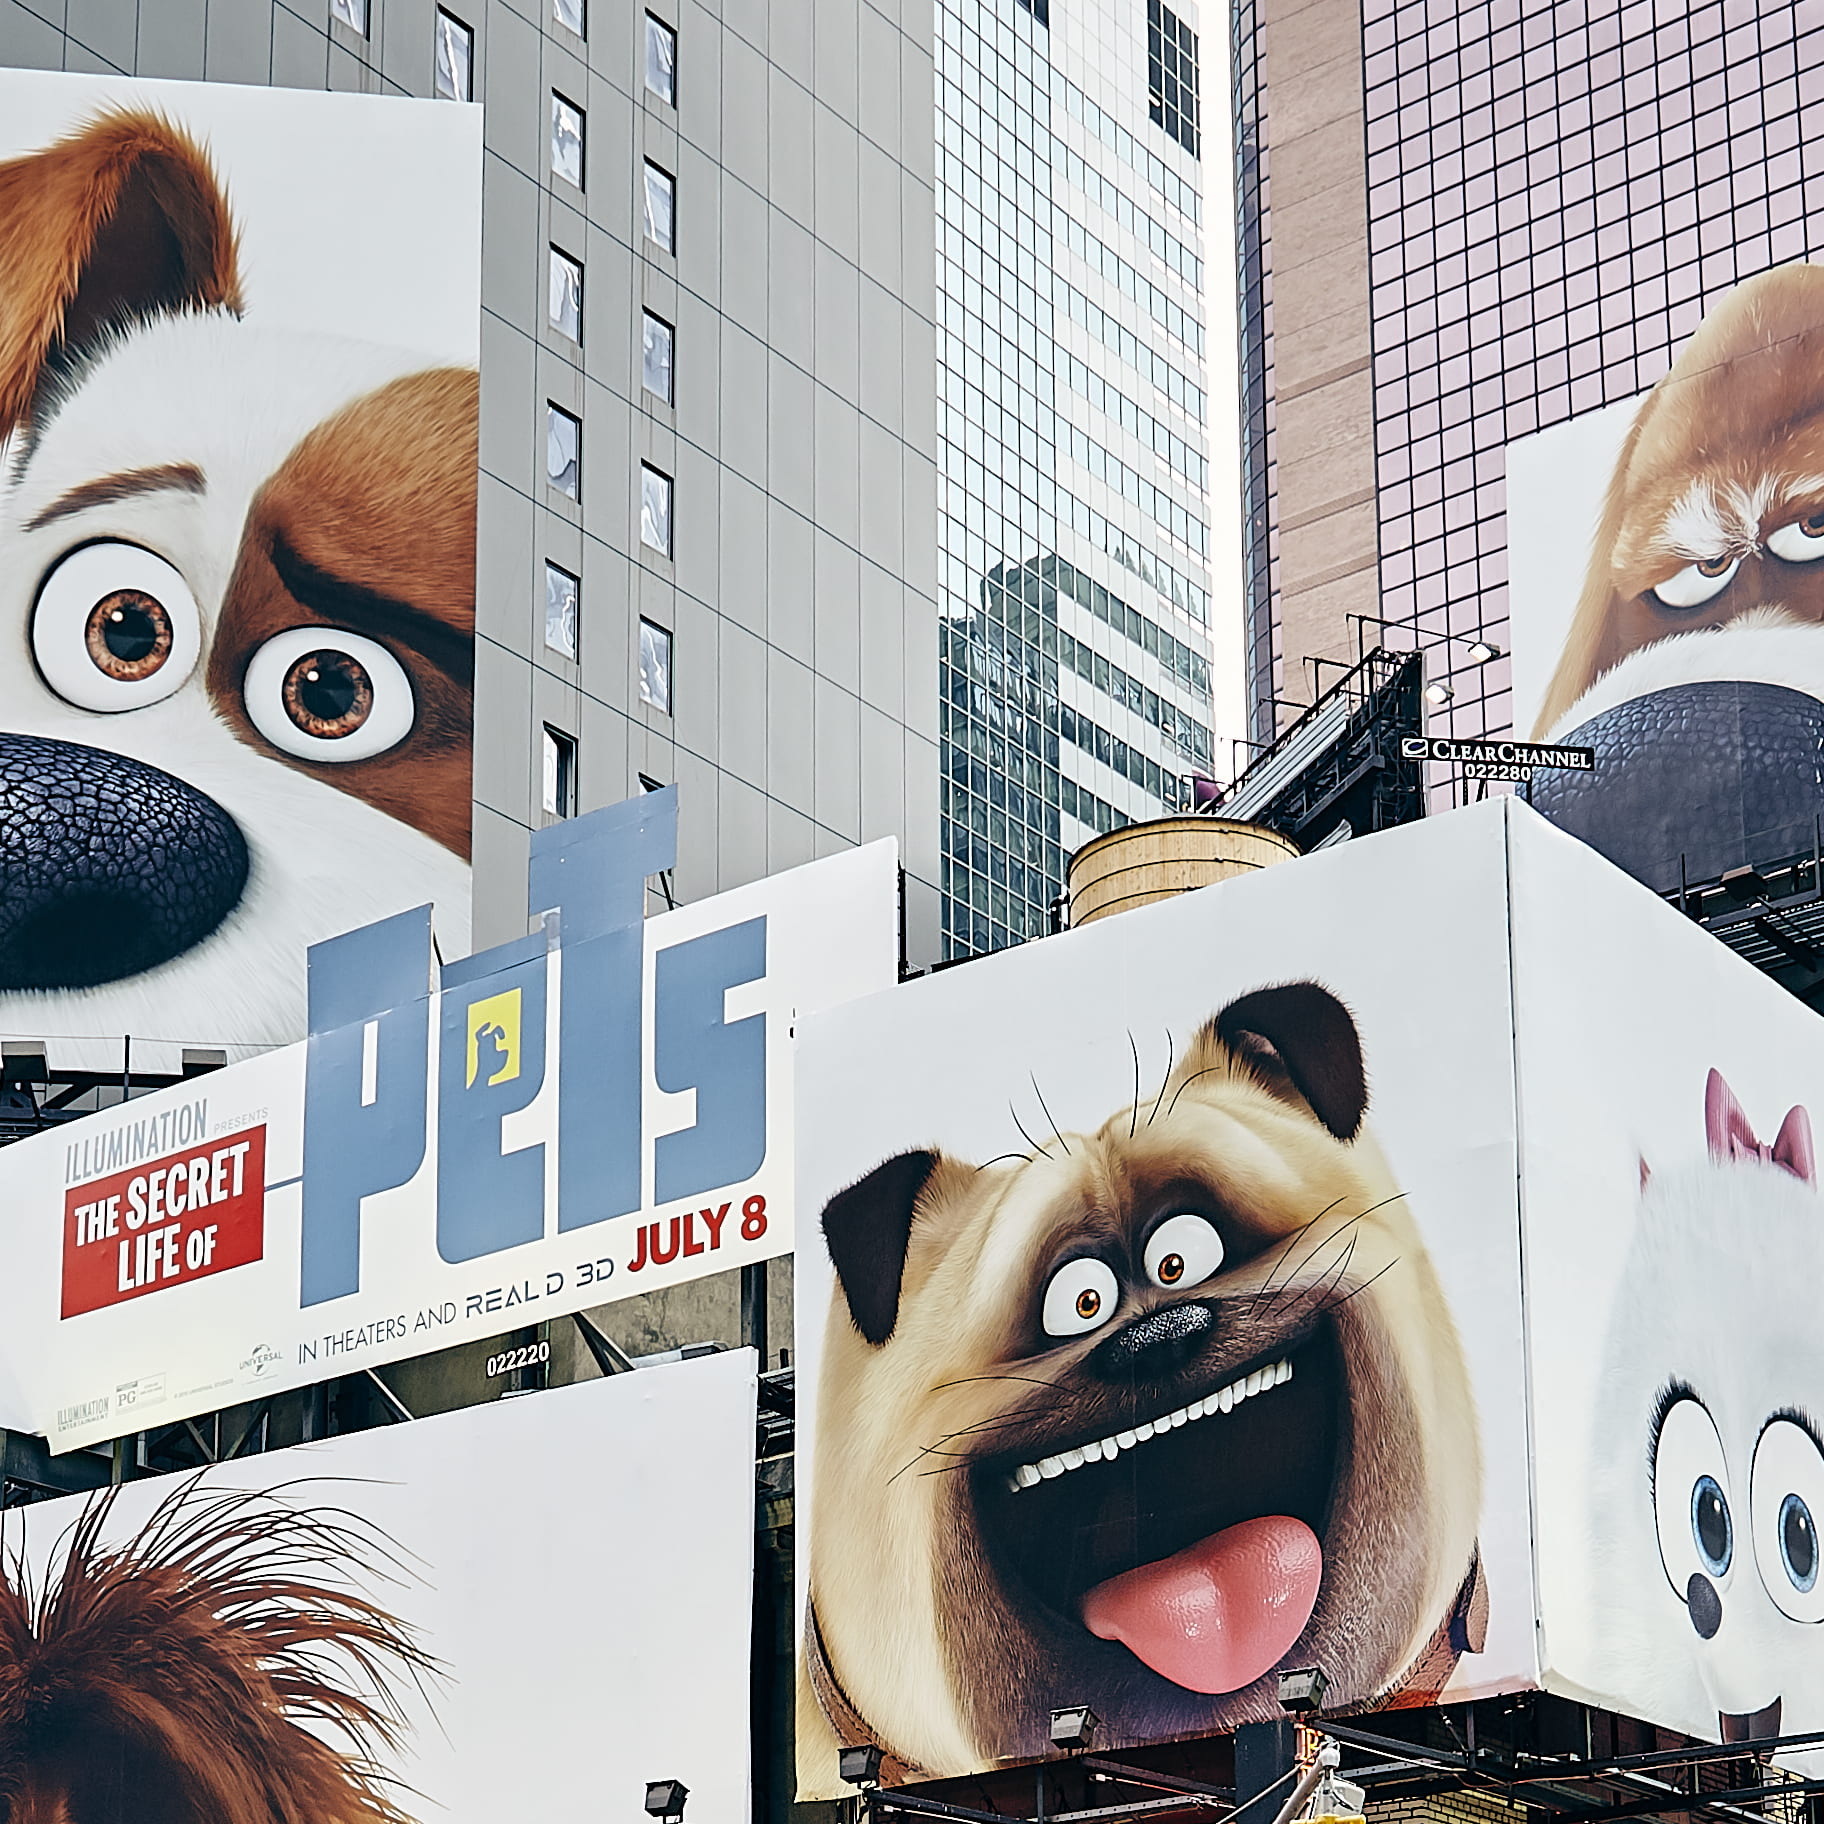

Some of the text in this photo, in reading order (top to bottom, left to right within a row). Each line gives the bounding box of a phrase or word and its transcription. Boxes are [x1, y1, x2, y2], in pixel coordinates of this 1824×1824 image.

[1433, 739, 1592, 770] CLEARCHANNEL
[1465, 762, 1531, 782] 022280
[65, 1097, 269, 1185] ILLUMINATION PRESENTS
[74, 1142, 250, 1247] THE SECRET
[117, 1221, 218, 1293] LIFE OF
[628, 1195, 768, 1274] JULY 8
[298, 1342, 318, 1366] IN
[322, 1315, 407, 1358] THEATERS
[414, 1302, 458, 1333] AND
[576, 1257, 615, 1288] 3D
[487, 1341, 550, 1378] 022220
[118, 1391, 136, 1409] PG
